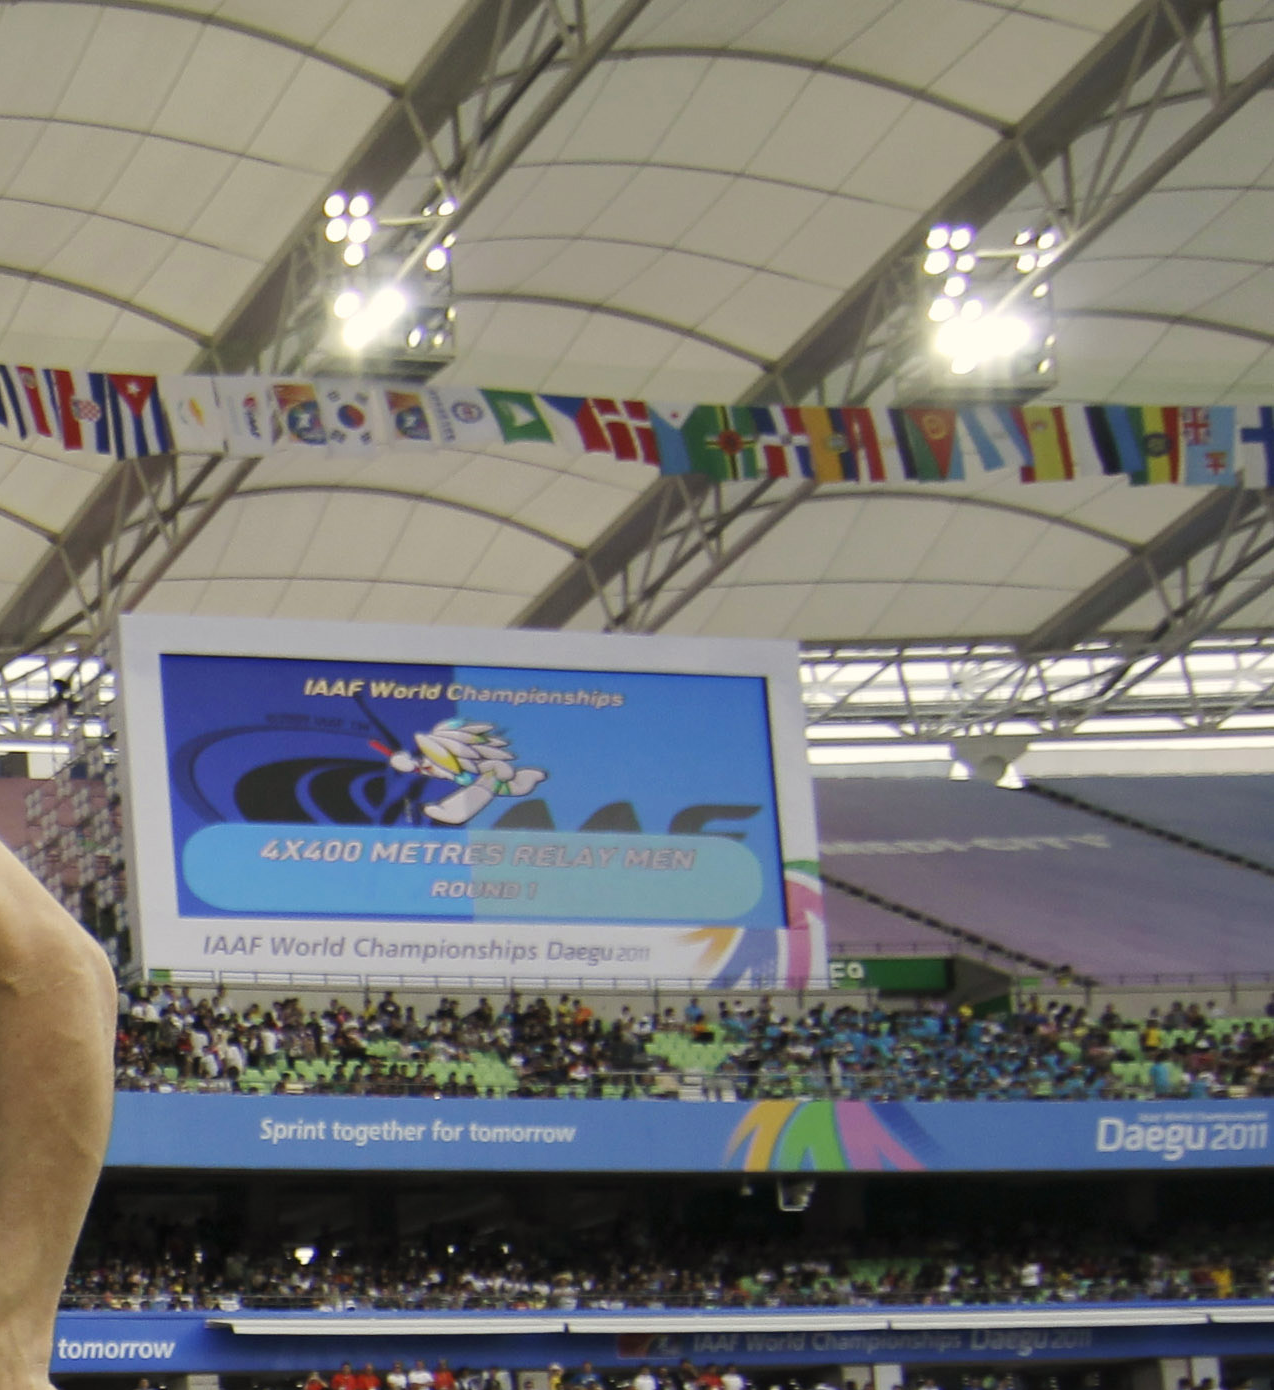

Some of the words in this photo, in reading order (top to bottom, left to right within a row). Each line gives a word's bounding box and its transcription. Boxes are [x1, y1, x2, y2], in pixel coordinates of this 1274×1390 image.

[304, 679, 365, 697] IAAF
[370, 682, 442, 700] World
[446, 684, 625, 708] Championships
[370, 842, 503, 866] METRES
[512, 846, 617, 868] RELAY
[624, 849, 695, 870] MEN
[431, 881, 521, 899] ROUND
[203, 936, 262, 956] IAAF
[270, 937, 344, 958] World
[353, 937, 537, 963] Championships
[546, 942, 613, 965] Daegu
[260, 1118, 326, 1145] Sprint
[332, 1120, 426, 1146] together
[432, 1121, 463, 1142] for
[470, 1123, 576, 1143] tomorrow
[1096, 1117, 1207, 1161] Daegu
[1210, 1122, 1268, 1151] 2011
[58, 1339, 175, 1360] tomorrow
[747, 1334, 806, 1352] World
